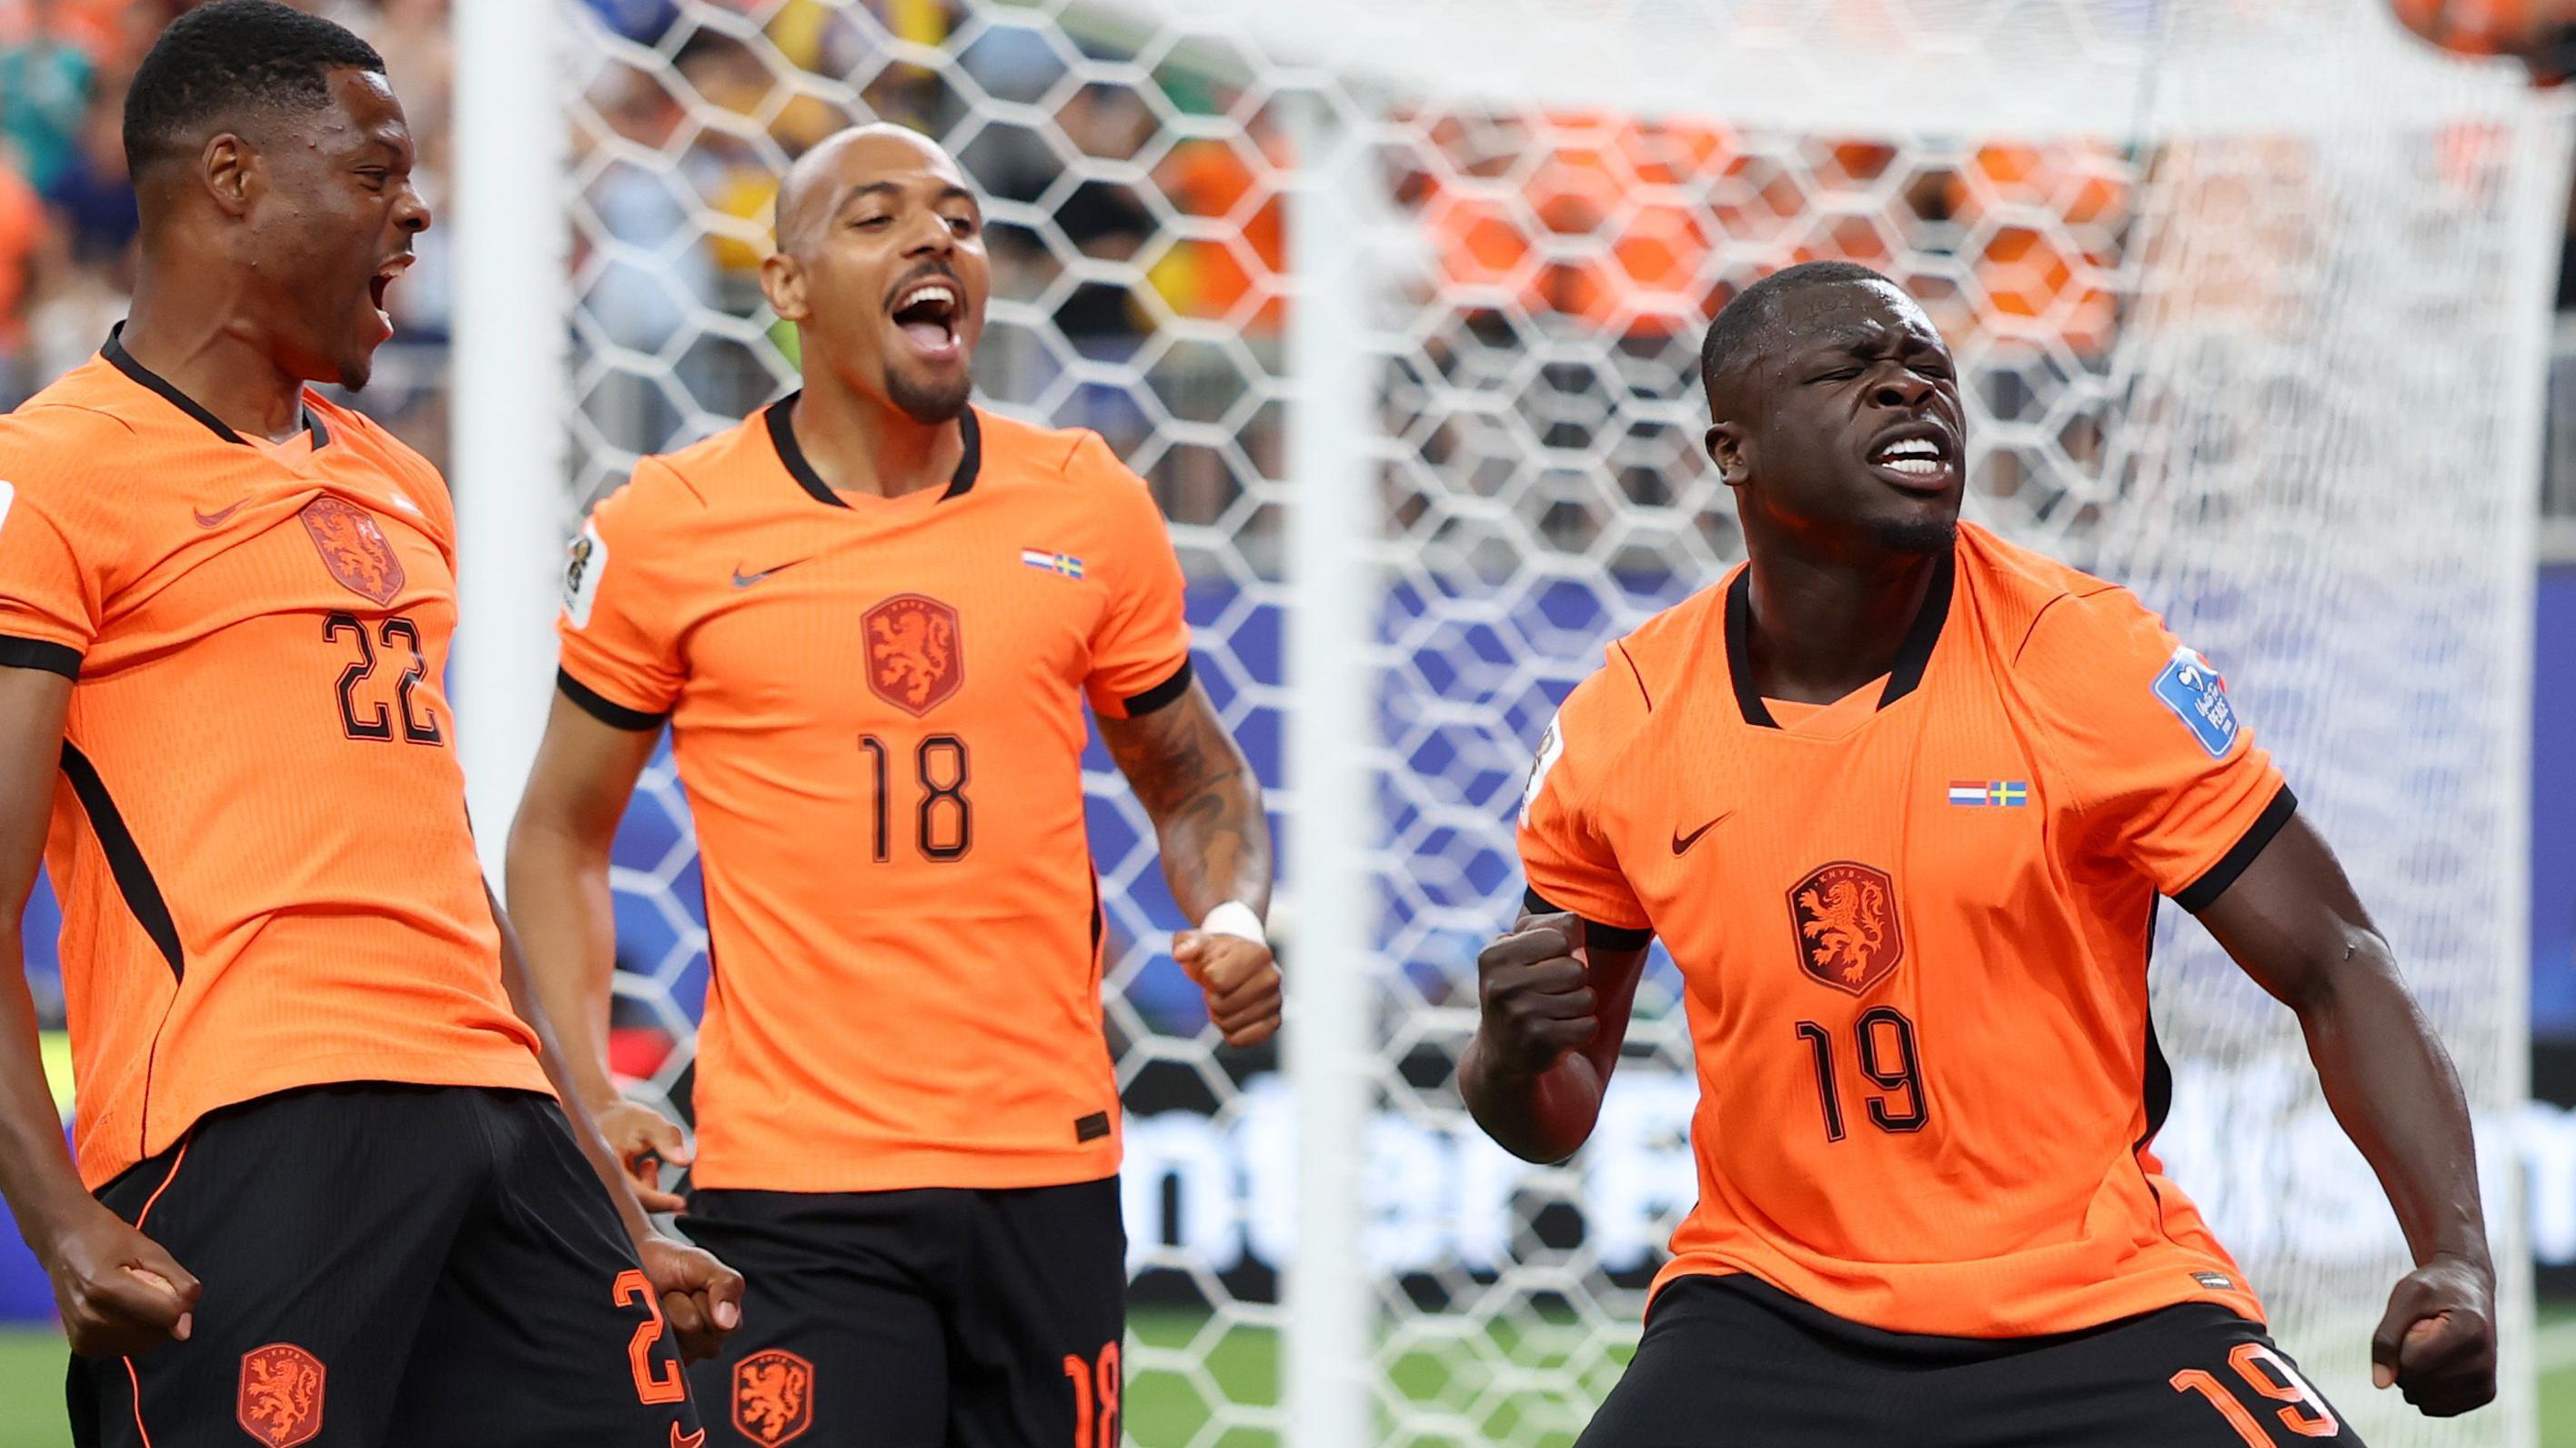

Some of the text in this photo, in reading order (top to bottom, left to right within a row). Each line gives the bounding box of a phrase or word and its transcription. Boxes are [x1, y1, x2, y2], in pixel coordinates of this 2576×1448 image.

[322, 610, 444, 747] 22
[859, 733, 973, 863] 18
[1819, 869, 1857, 883] KNVB
[1796, 1005, 1929, 1143] 19
[1062, 1339, 1122, 1448] 18
[2168, 1342, 2340, 1448] 19
